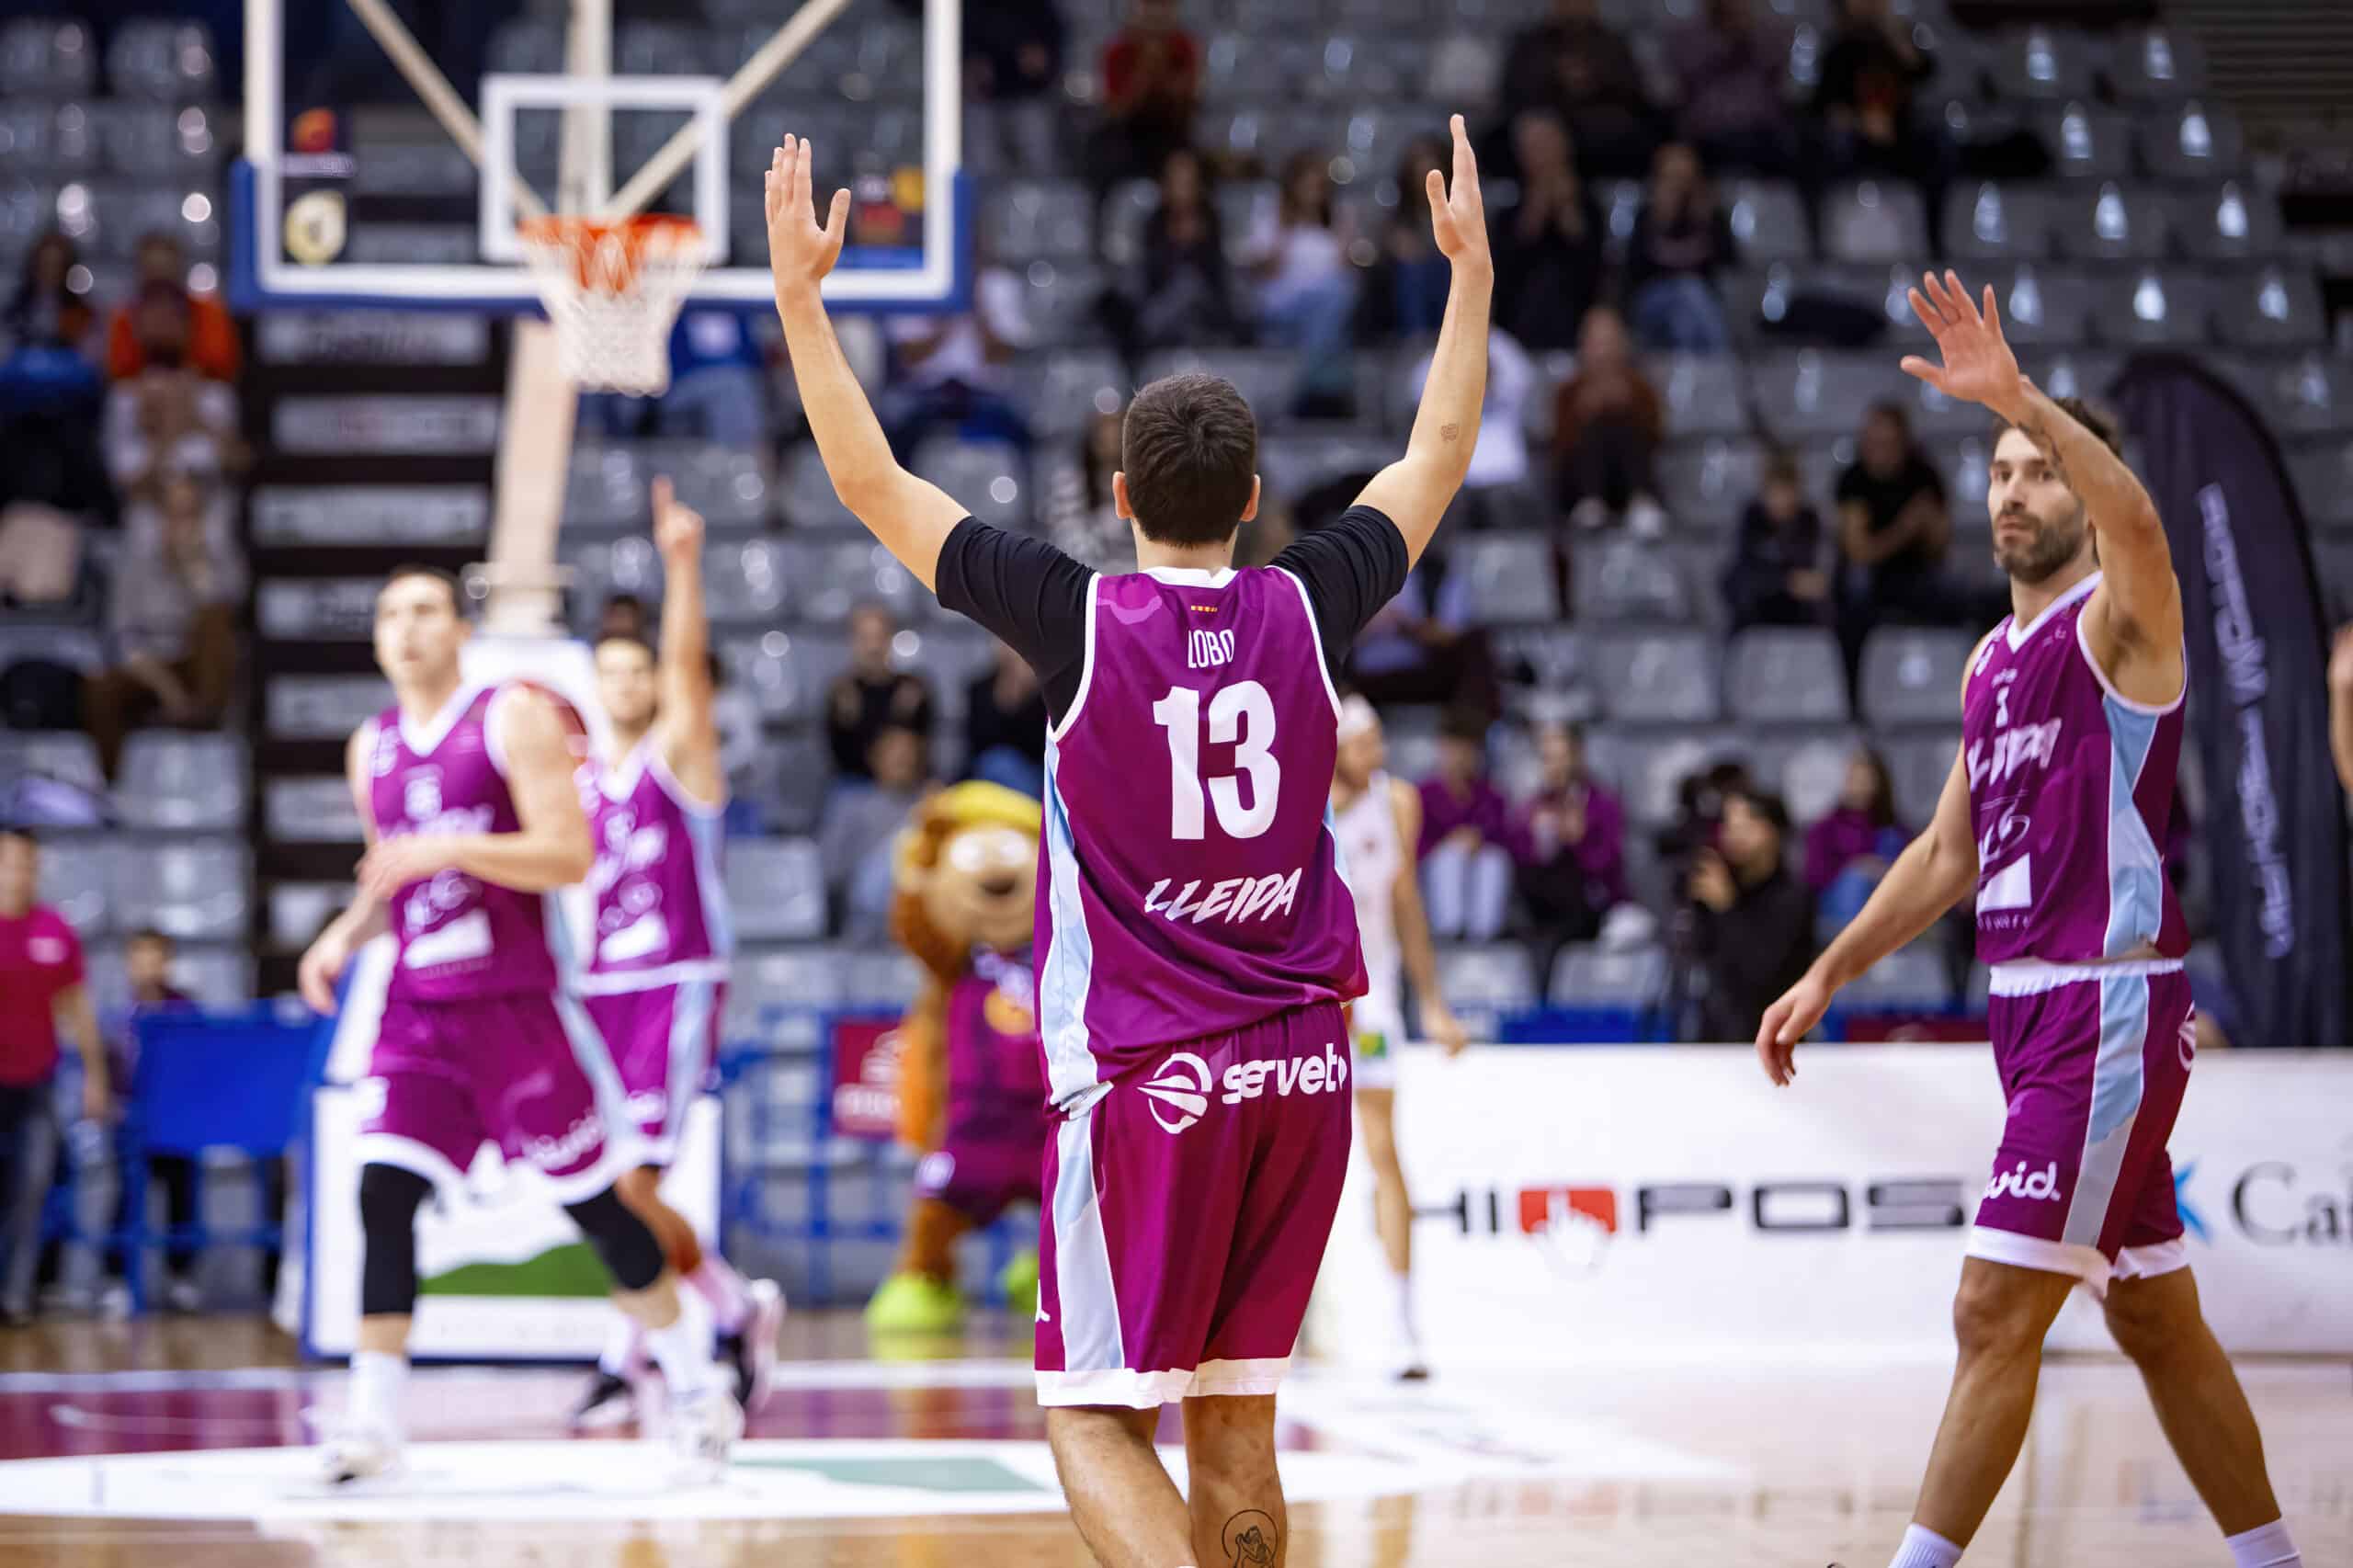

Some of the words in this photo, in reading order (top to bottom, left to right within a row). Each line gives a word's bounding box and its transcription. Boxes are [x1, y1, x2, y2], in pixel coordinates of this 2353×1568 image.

[1188, 629, 1235, 669] LOBO
[1152, 679, 1281, 841] 13
[1144, 867, 1302, 925] LLEIDA
